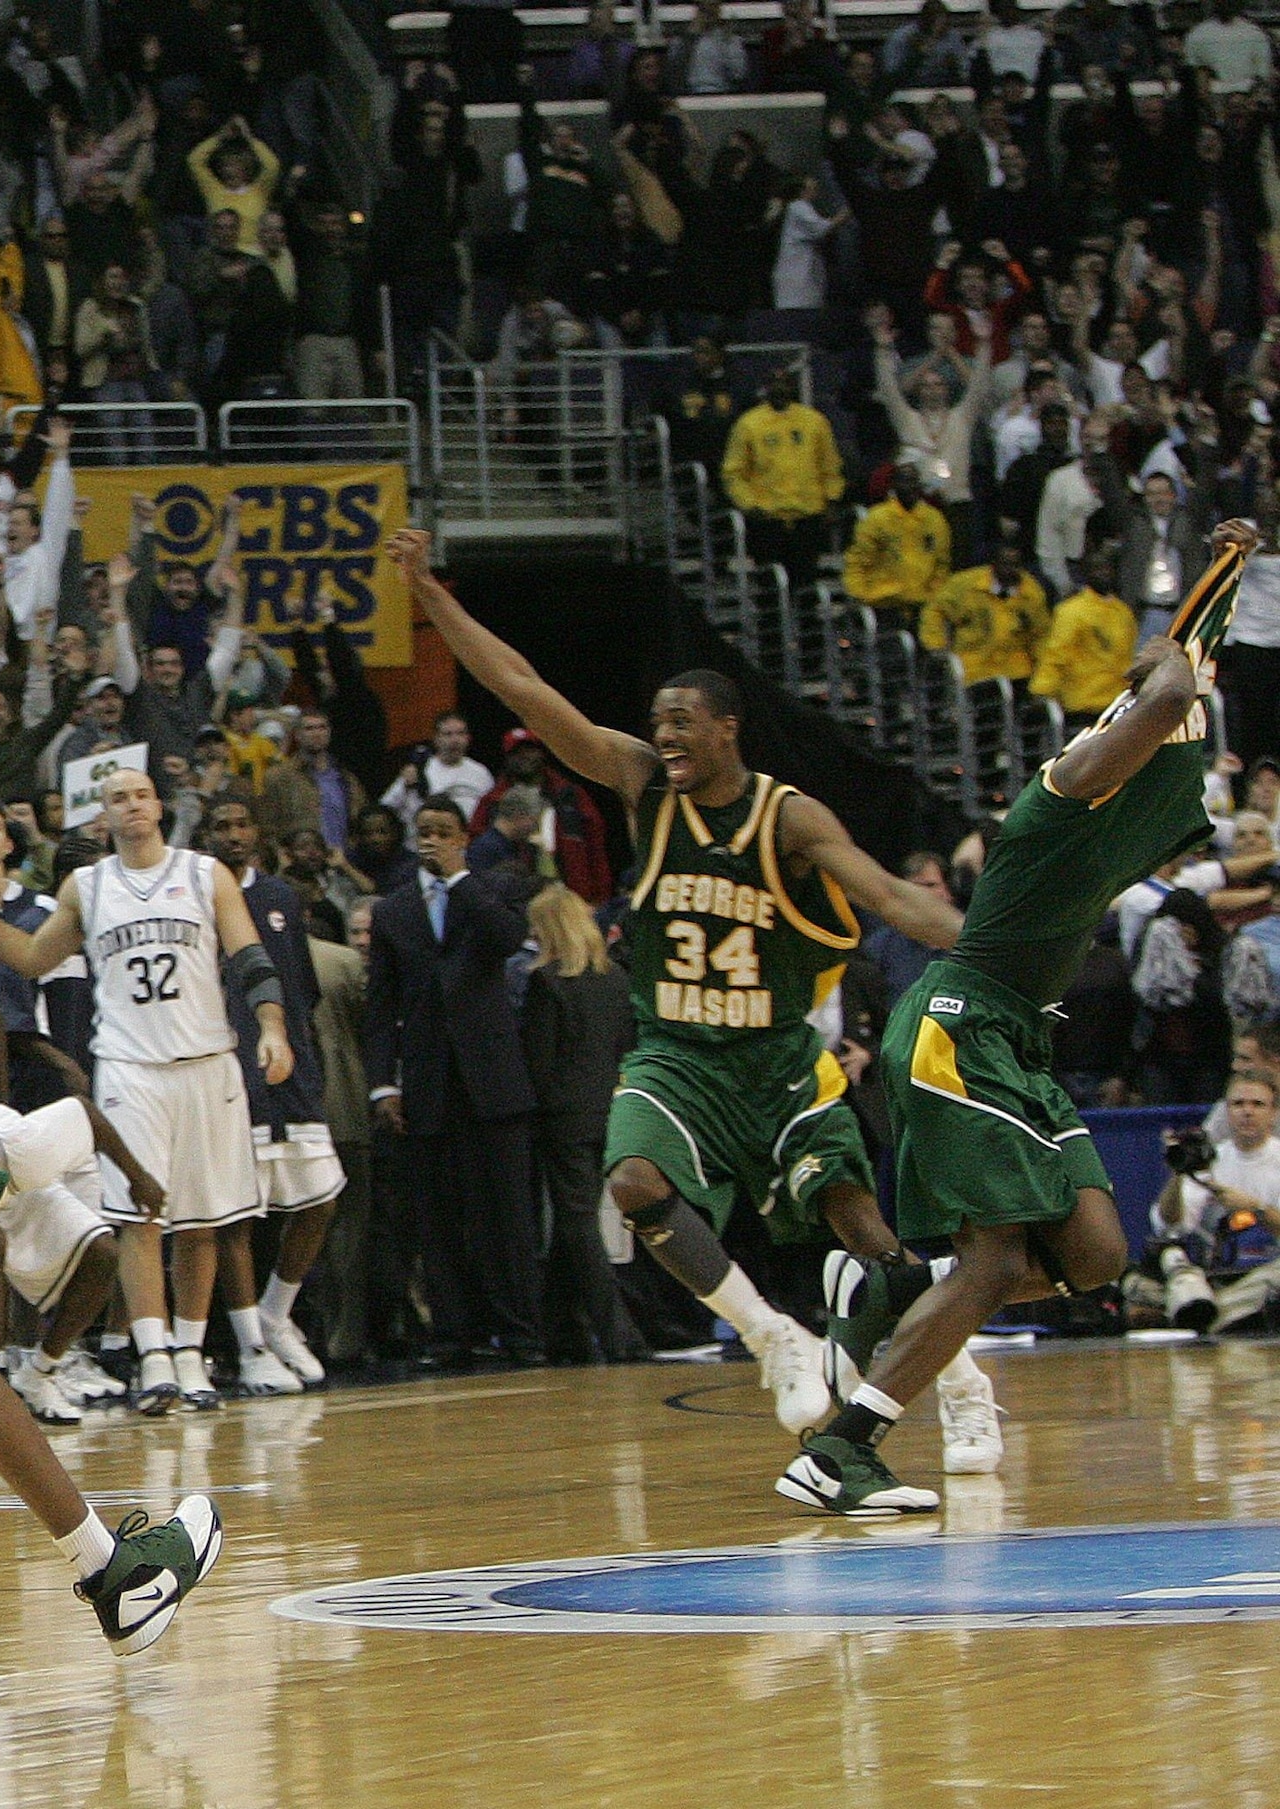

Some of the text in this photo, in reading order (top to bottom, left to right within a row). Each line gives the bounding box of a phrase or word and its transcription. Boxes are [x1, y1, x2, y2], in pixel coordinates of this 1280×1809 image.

[233, 484, 381, 553] CBS
[238, 556, 377, 625] RTS
[655, 873, 775, 931] GEORGE
[127, 952, 181, 1004] 32
[664, 919, 761, 987] 34
[654, 979, 773, 1029] MASON
